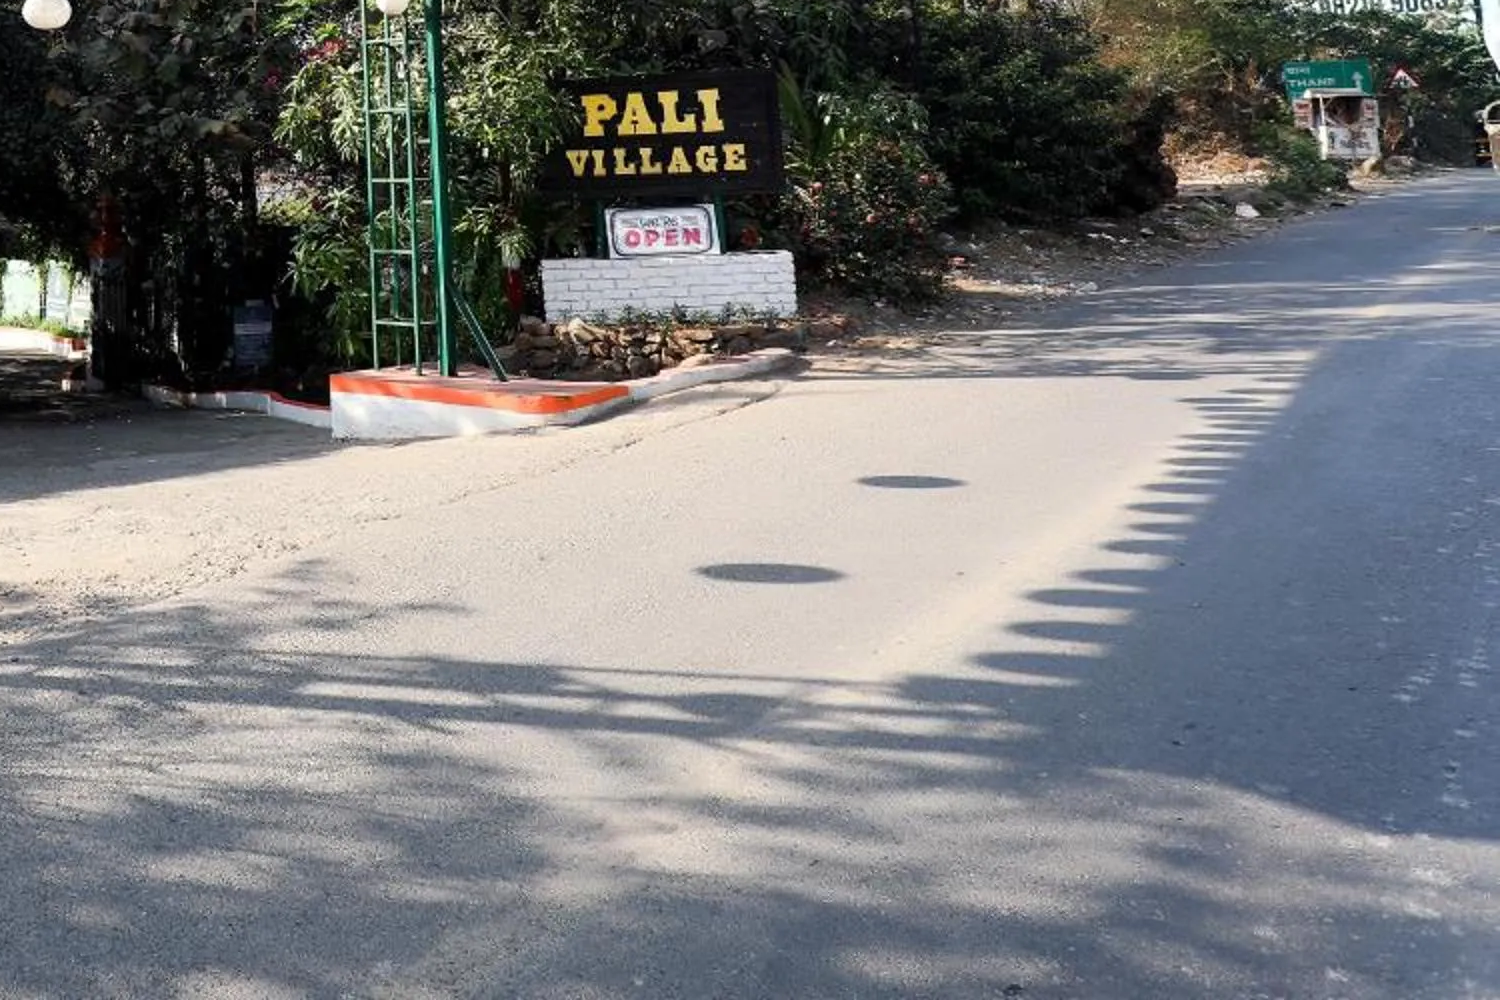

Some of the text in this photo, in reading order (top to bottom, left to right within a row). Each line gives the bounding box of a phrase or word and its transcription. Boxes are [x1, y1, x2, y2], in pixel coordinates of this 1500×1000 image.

[581, 88, 725, 137] PALI
[565, 143, 748, 177] VILLAGE
[625, 227, 702, 249] OPEN
